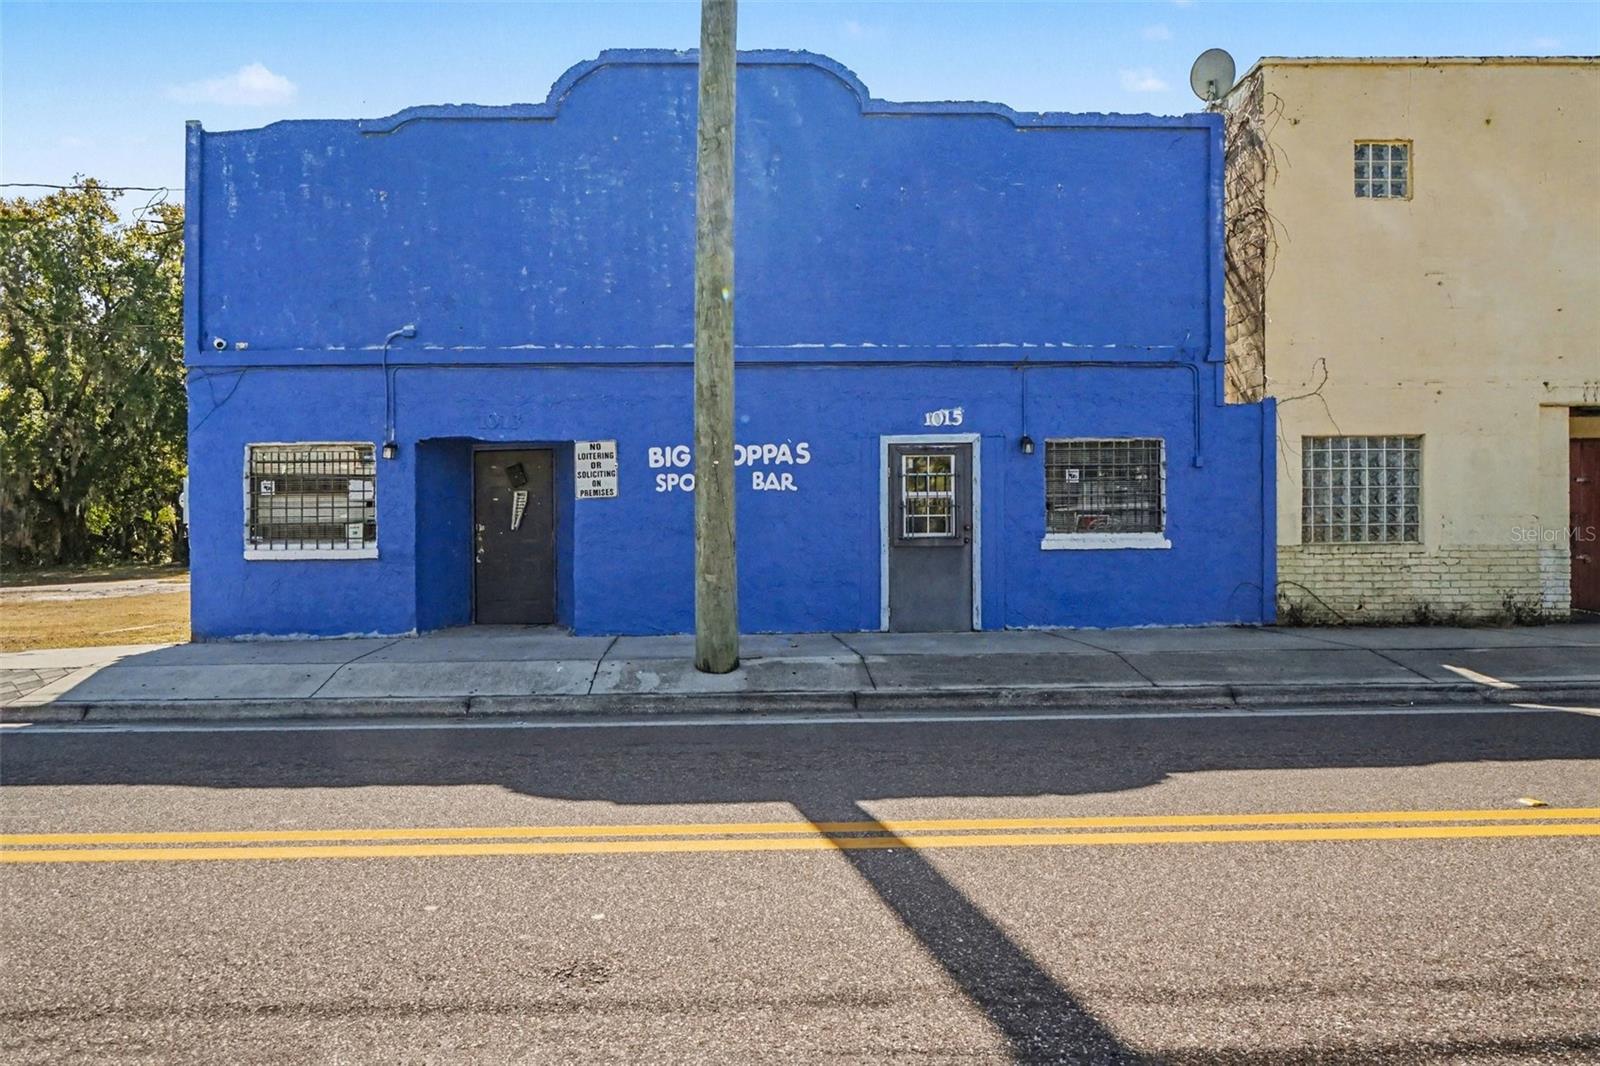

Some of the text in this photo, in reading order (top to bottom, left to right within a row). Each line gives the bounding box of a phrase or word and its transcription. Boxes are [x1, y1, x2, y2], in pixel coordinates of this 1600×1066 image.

[923, 407, 963, 427] 1015
[589, 443, 602, 451] NO
[577, 452, 614, 460] LOITERING
[648, 438, 811, 468] BIG OPPA'S
[590, 461, 602, 469] OR
[577, 470, 616, 479] SOLICITING
[656, 471, 798, 492] SPO BAR
[580, 488, 614, 497] PREMISES
